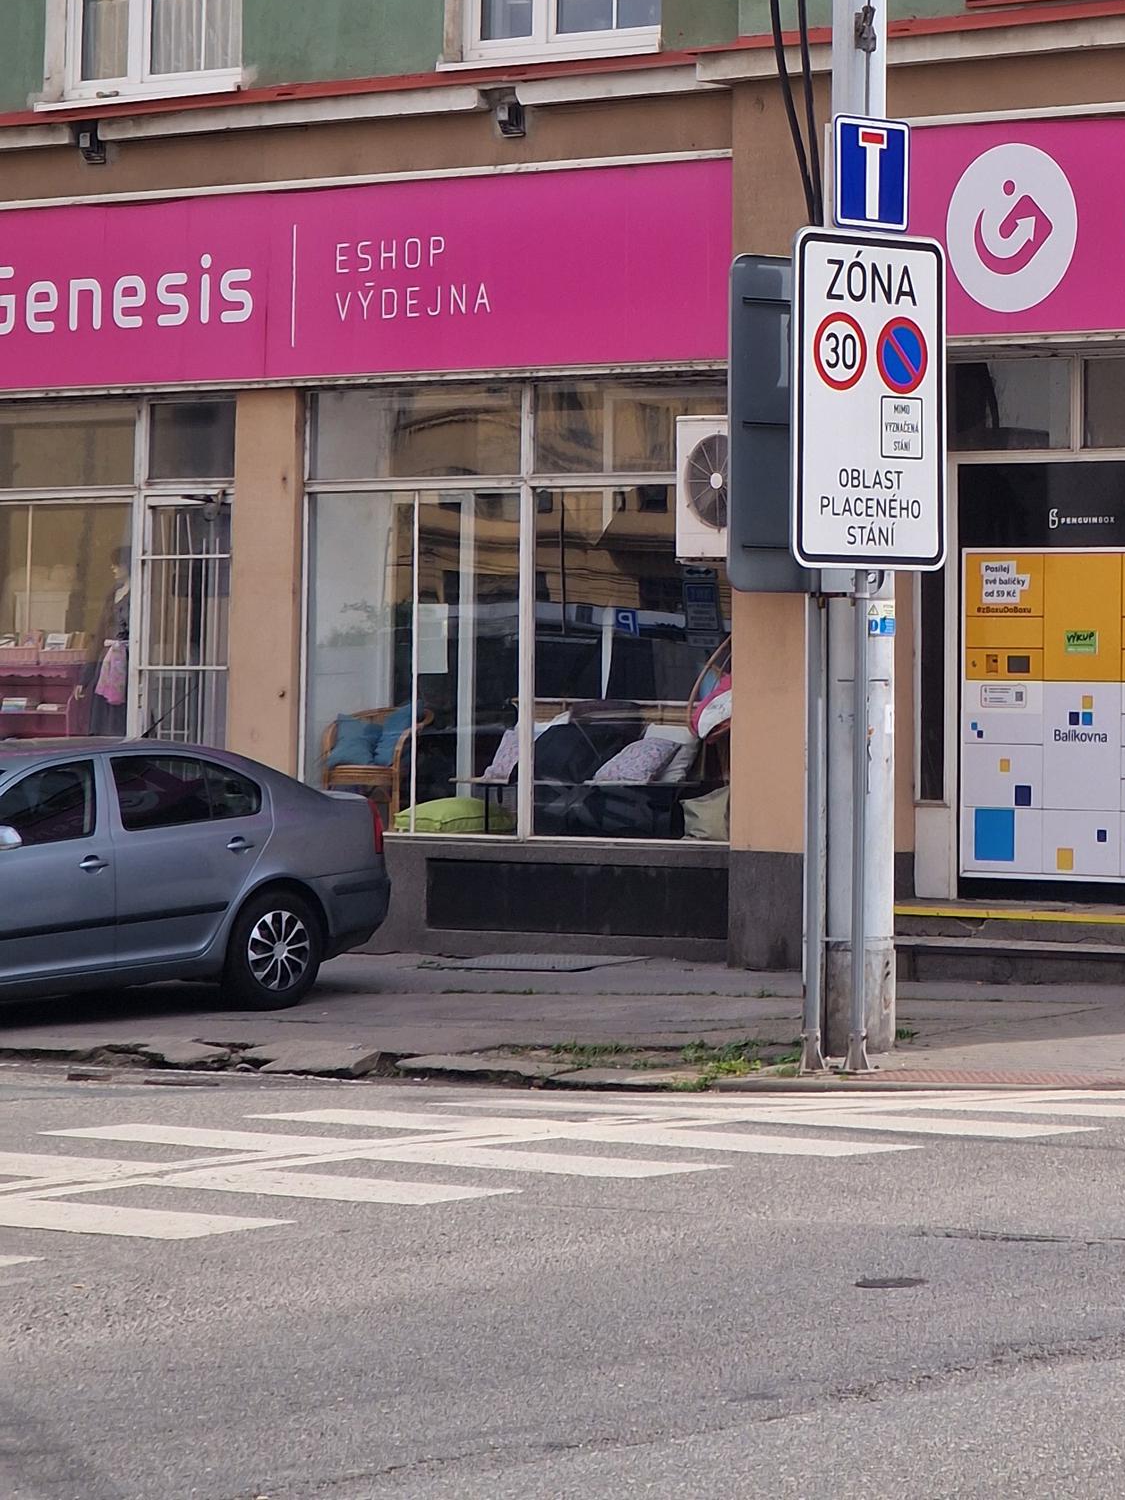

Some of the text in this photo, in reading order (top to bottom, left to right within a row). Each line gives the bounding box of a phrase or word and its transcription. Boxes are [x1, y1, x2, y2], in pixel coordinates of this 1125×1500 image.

[335, 236, 445, 273] ESHOP
[826, 250, 917, 306] ZÓNA
[335, 282, 491, 321] VÝDEJNA
[825, 332, 856, 370] 30
[894, 404, 910, 415] MIMO
[885, 420, 919, 433] VYZNAČENÁ
[893, 439, 911, 451] STÁNÍ
[838, 468, 903, 490] OBLAST
[820, 493, 921, 519] PLACENÉHO
[847, 521, 896, 547] STÁNÍ
[996, 590, 1005, 598] 59
[1006, 590, 1017, 598] Kč
[1054, 729, 1108, 743] Balíkovna
